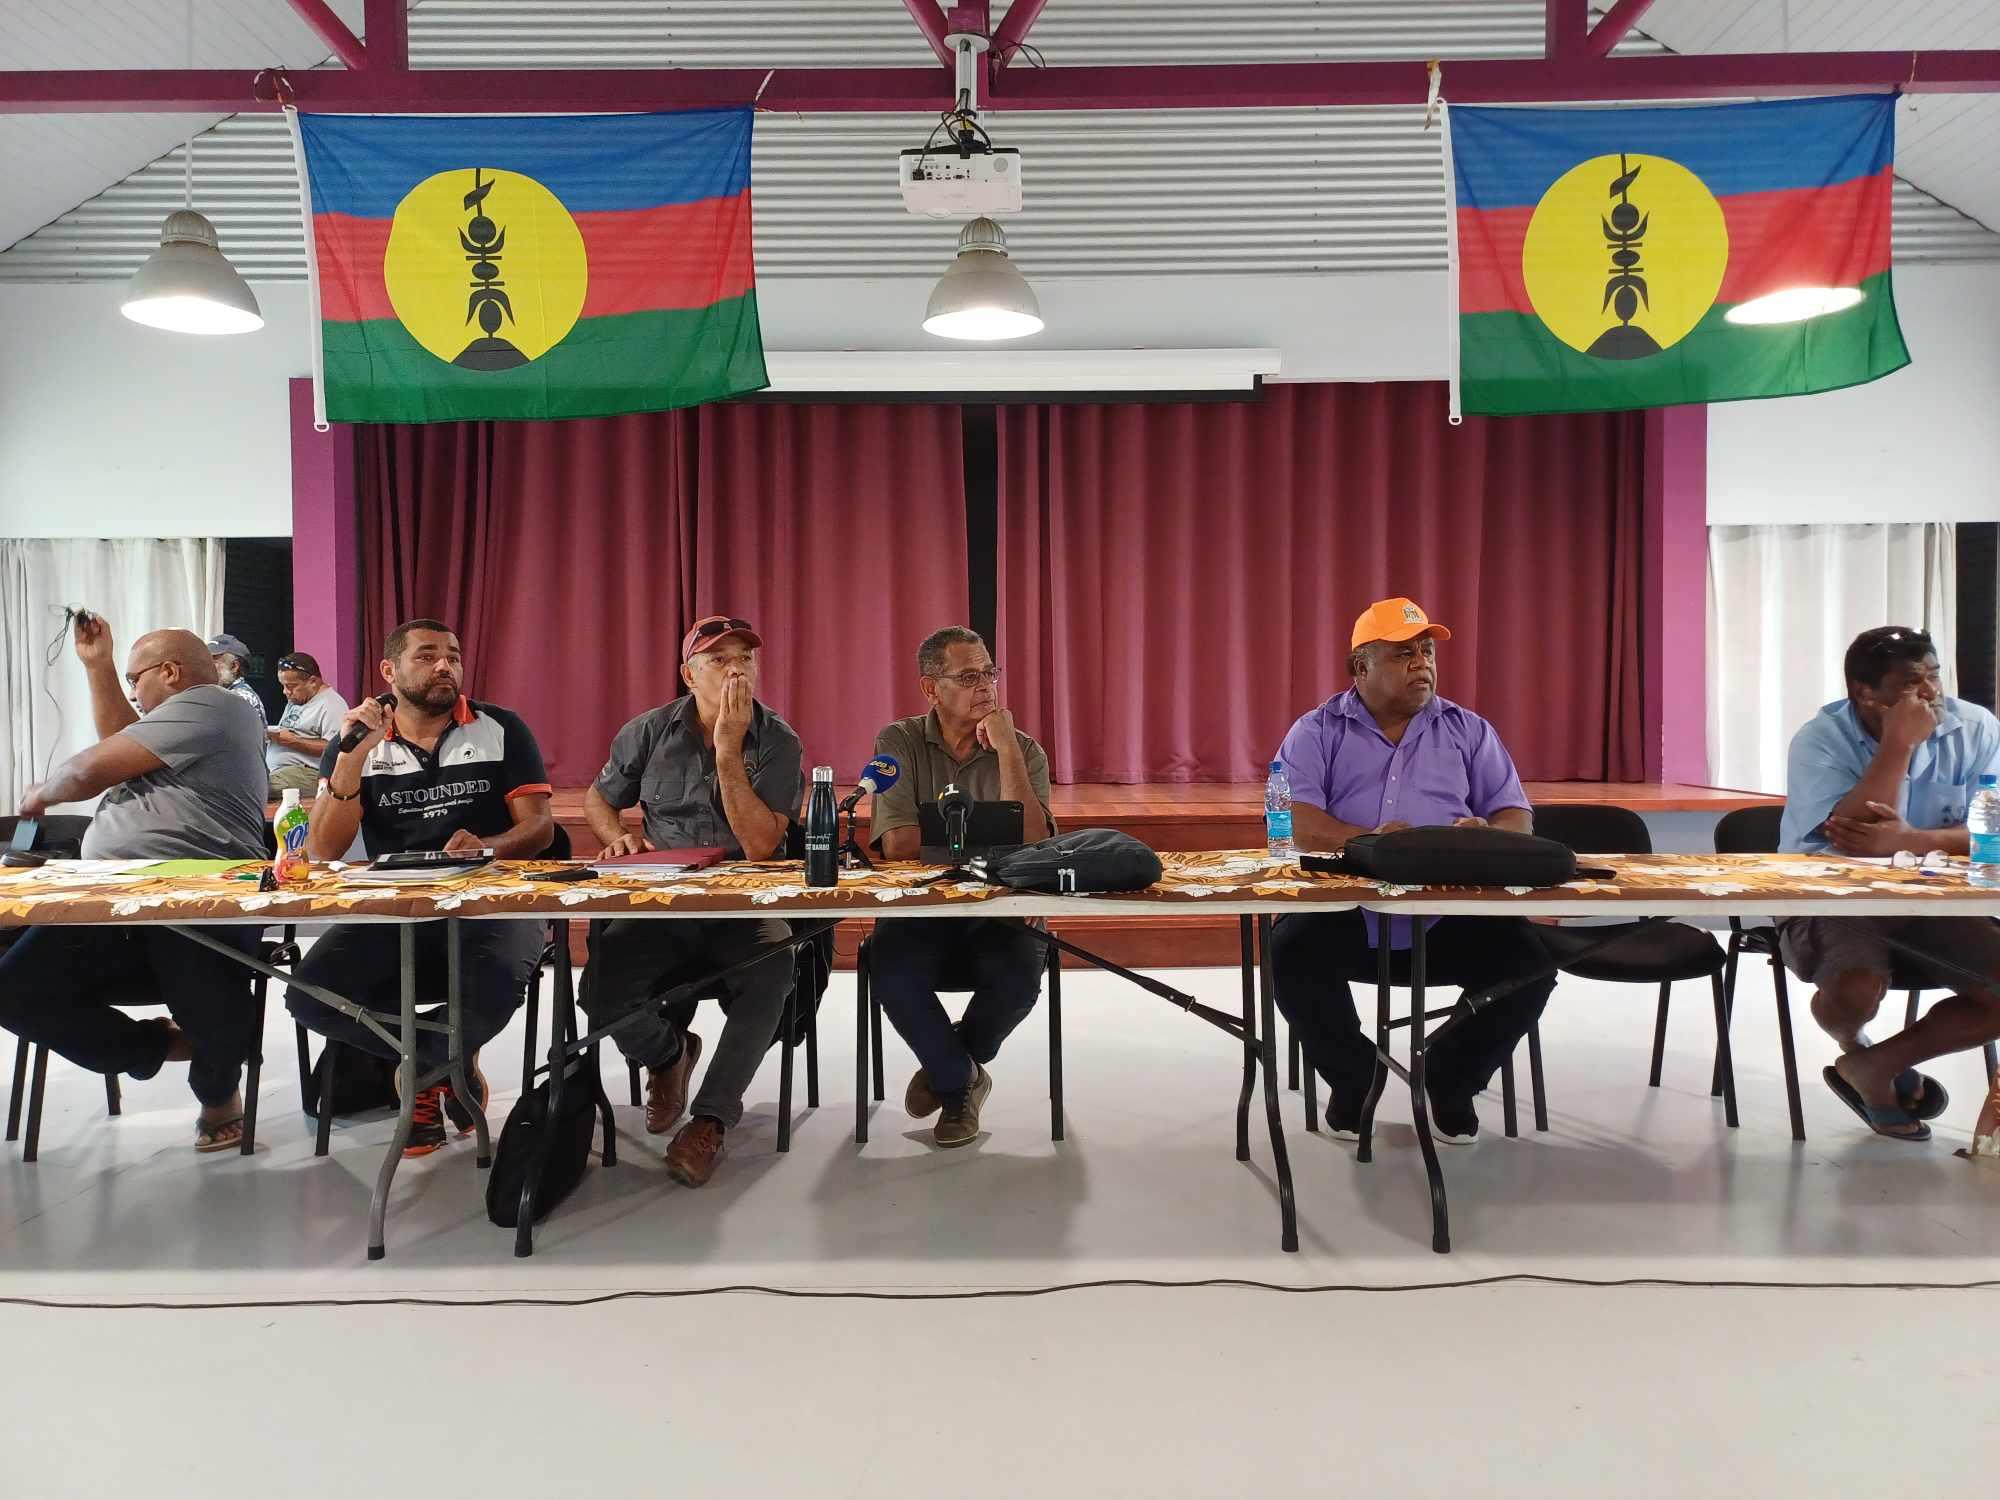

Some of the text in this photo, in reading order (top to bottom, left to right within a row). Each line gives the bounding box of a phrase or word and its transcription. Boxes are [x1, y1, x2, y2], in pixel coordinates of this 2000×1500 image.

[378, 779, 491, 806] ASTOUNDED
[944, 783, 960, 796] 1
[423, 808, 449, 819] 1979
